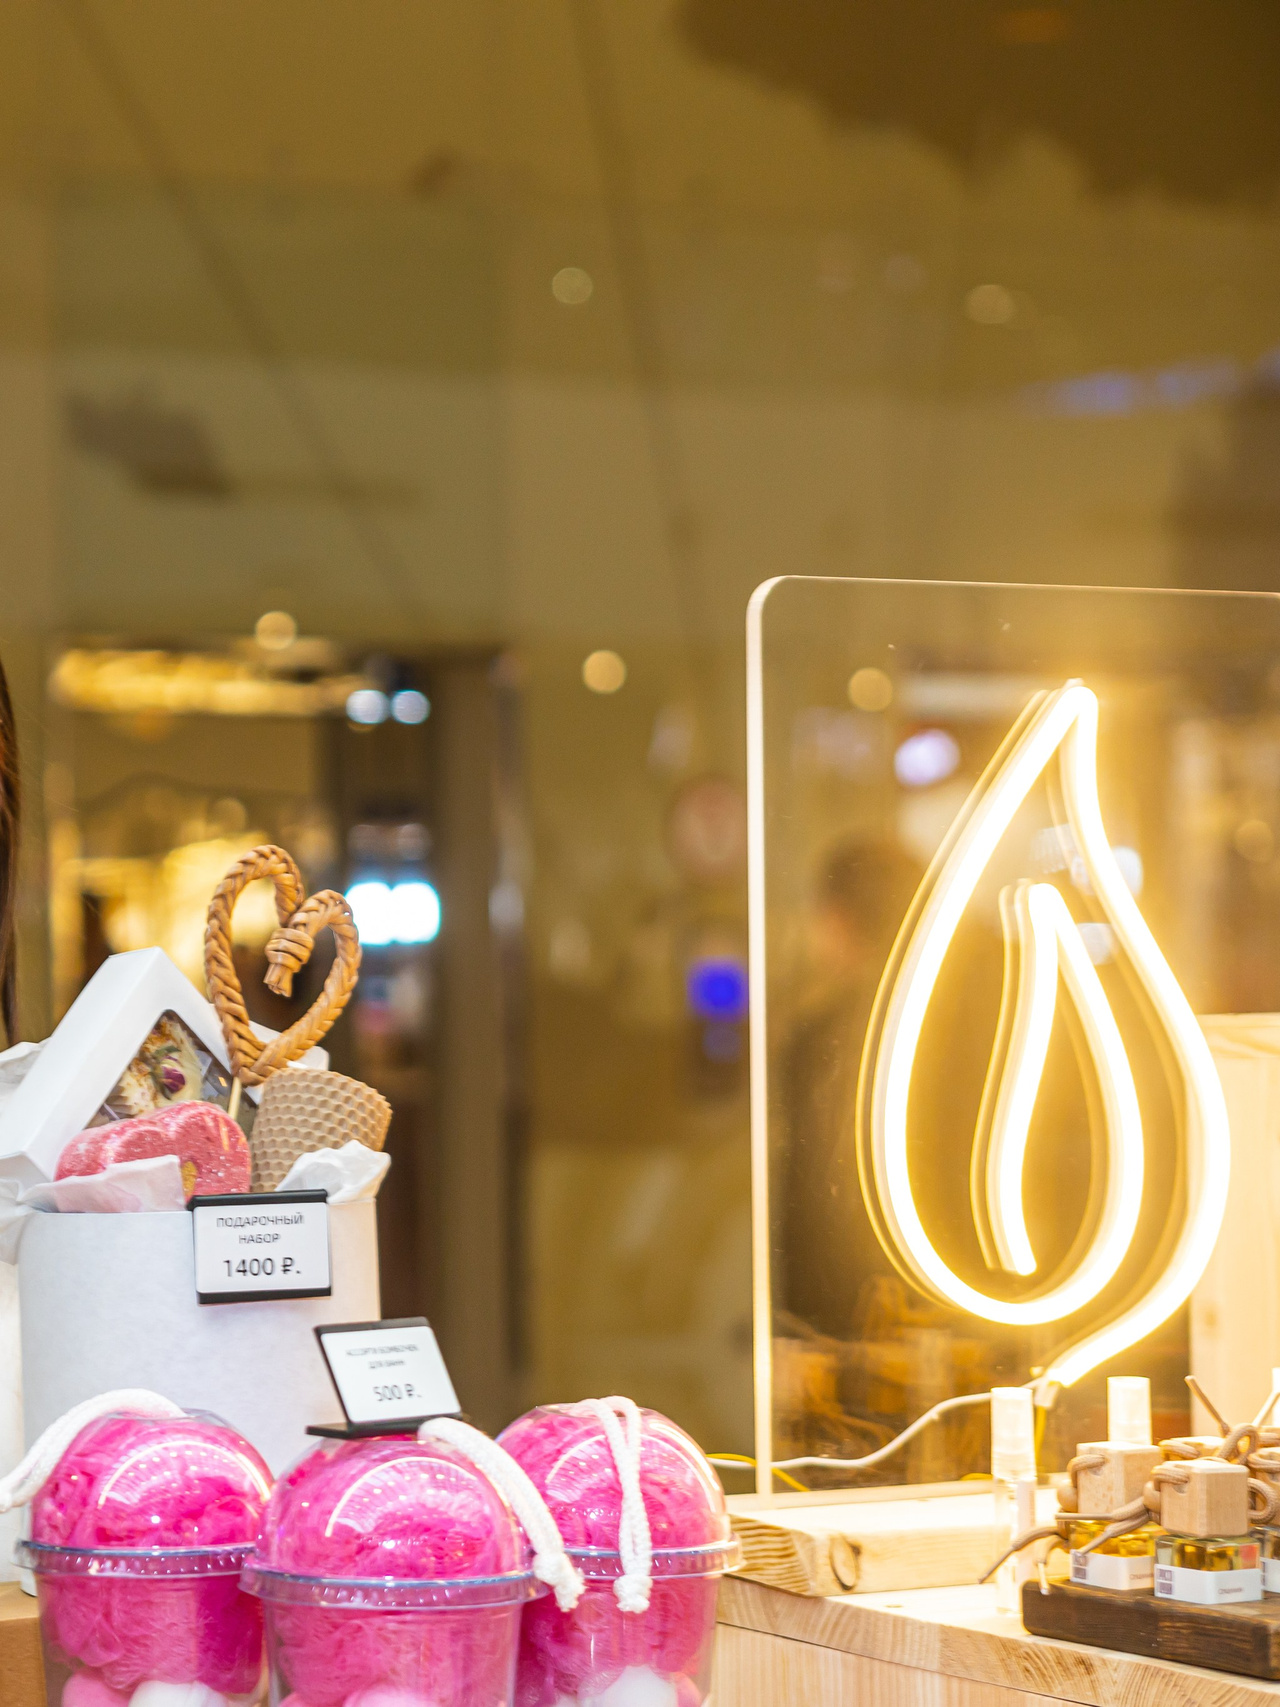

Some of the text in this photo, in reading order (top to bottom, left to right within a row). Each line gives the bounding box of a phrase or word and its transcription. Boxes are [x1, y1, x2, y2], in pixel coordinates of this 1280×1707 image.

[216, 1212, 304, 1228] ПОДАРОЧНЫЙ
[239, 1233, 281, 1244] НАБОР
[223, 1258, 275, 1277] 1400
[373, 1384, 402, 1402] 500
